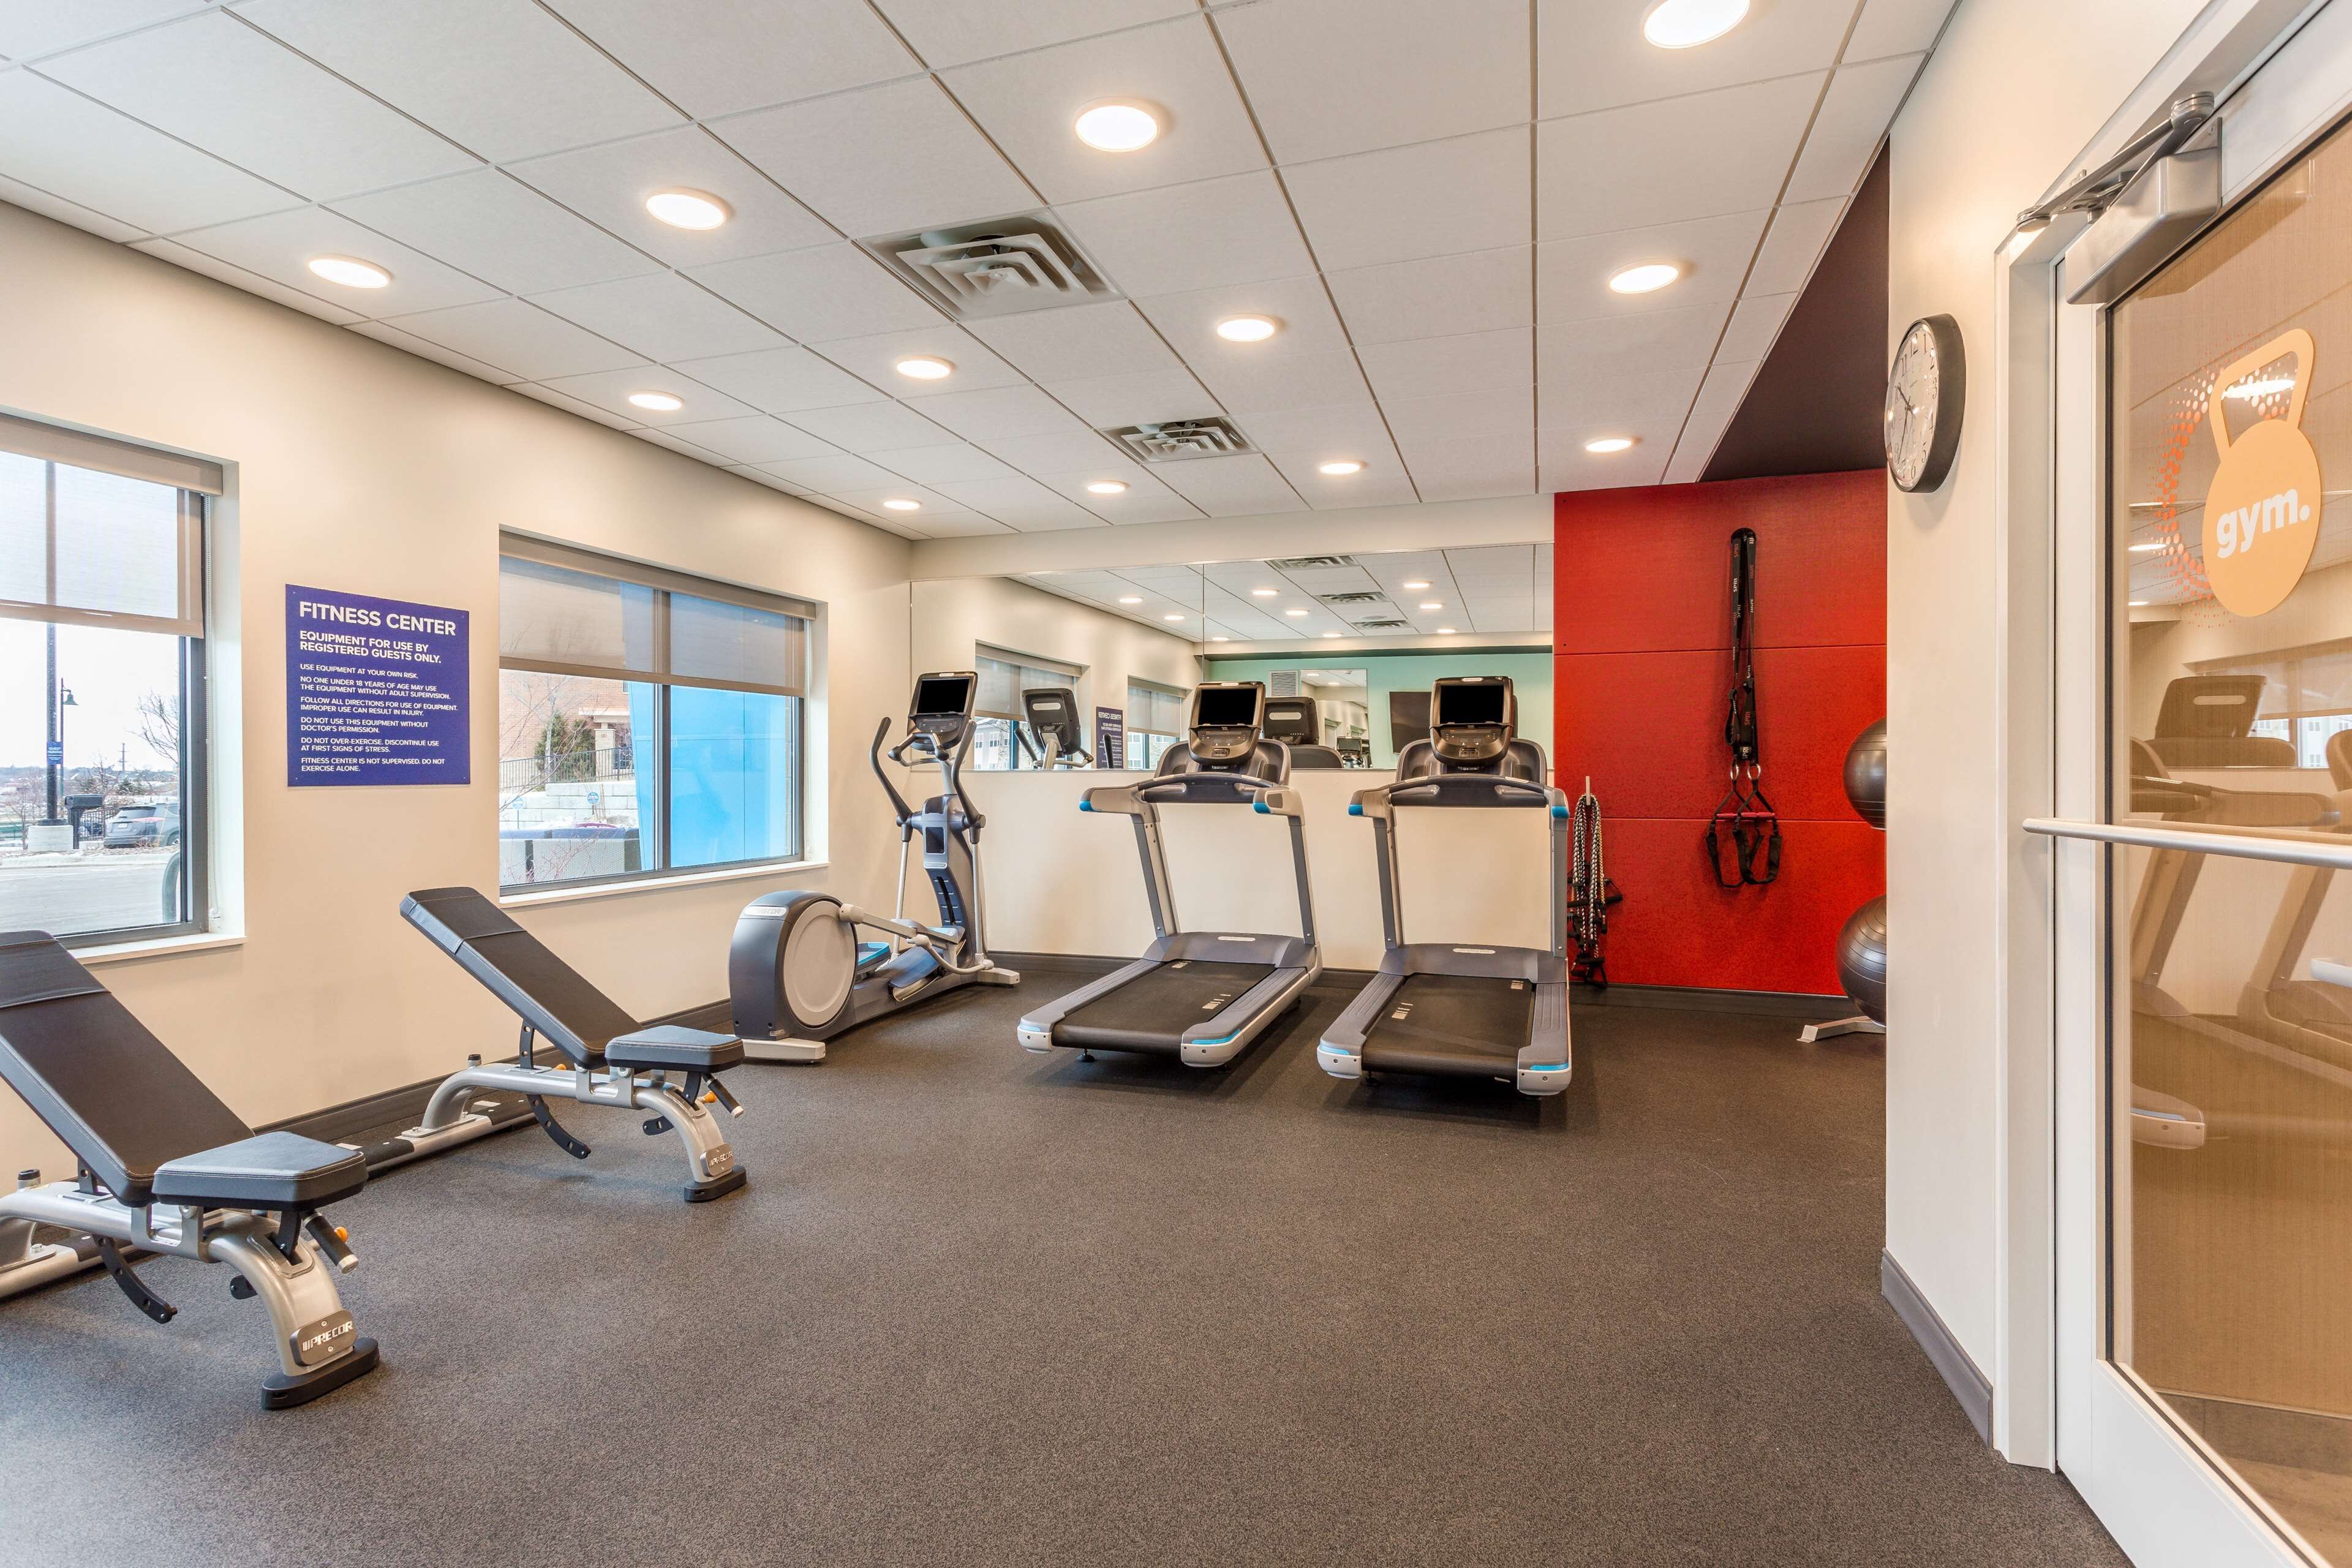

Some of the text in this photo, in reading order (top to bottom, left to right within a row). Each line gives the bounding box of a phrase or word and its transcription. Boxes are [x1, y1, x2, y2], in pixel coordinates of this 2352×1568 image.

[2217, 489, 2310, 559] gym.
[300, 601, 456, 636] FITNESS CENTER
[300, 630, 429, 652] EQUIPMENT FOR USE BY
[300, 641, 441, 663] REGISTERED GUESTS ONLY.
[712, 1152, 733, 1165] PRECOR
[311, 1321, 353, 1348] PRECOR
